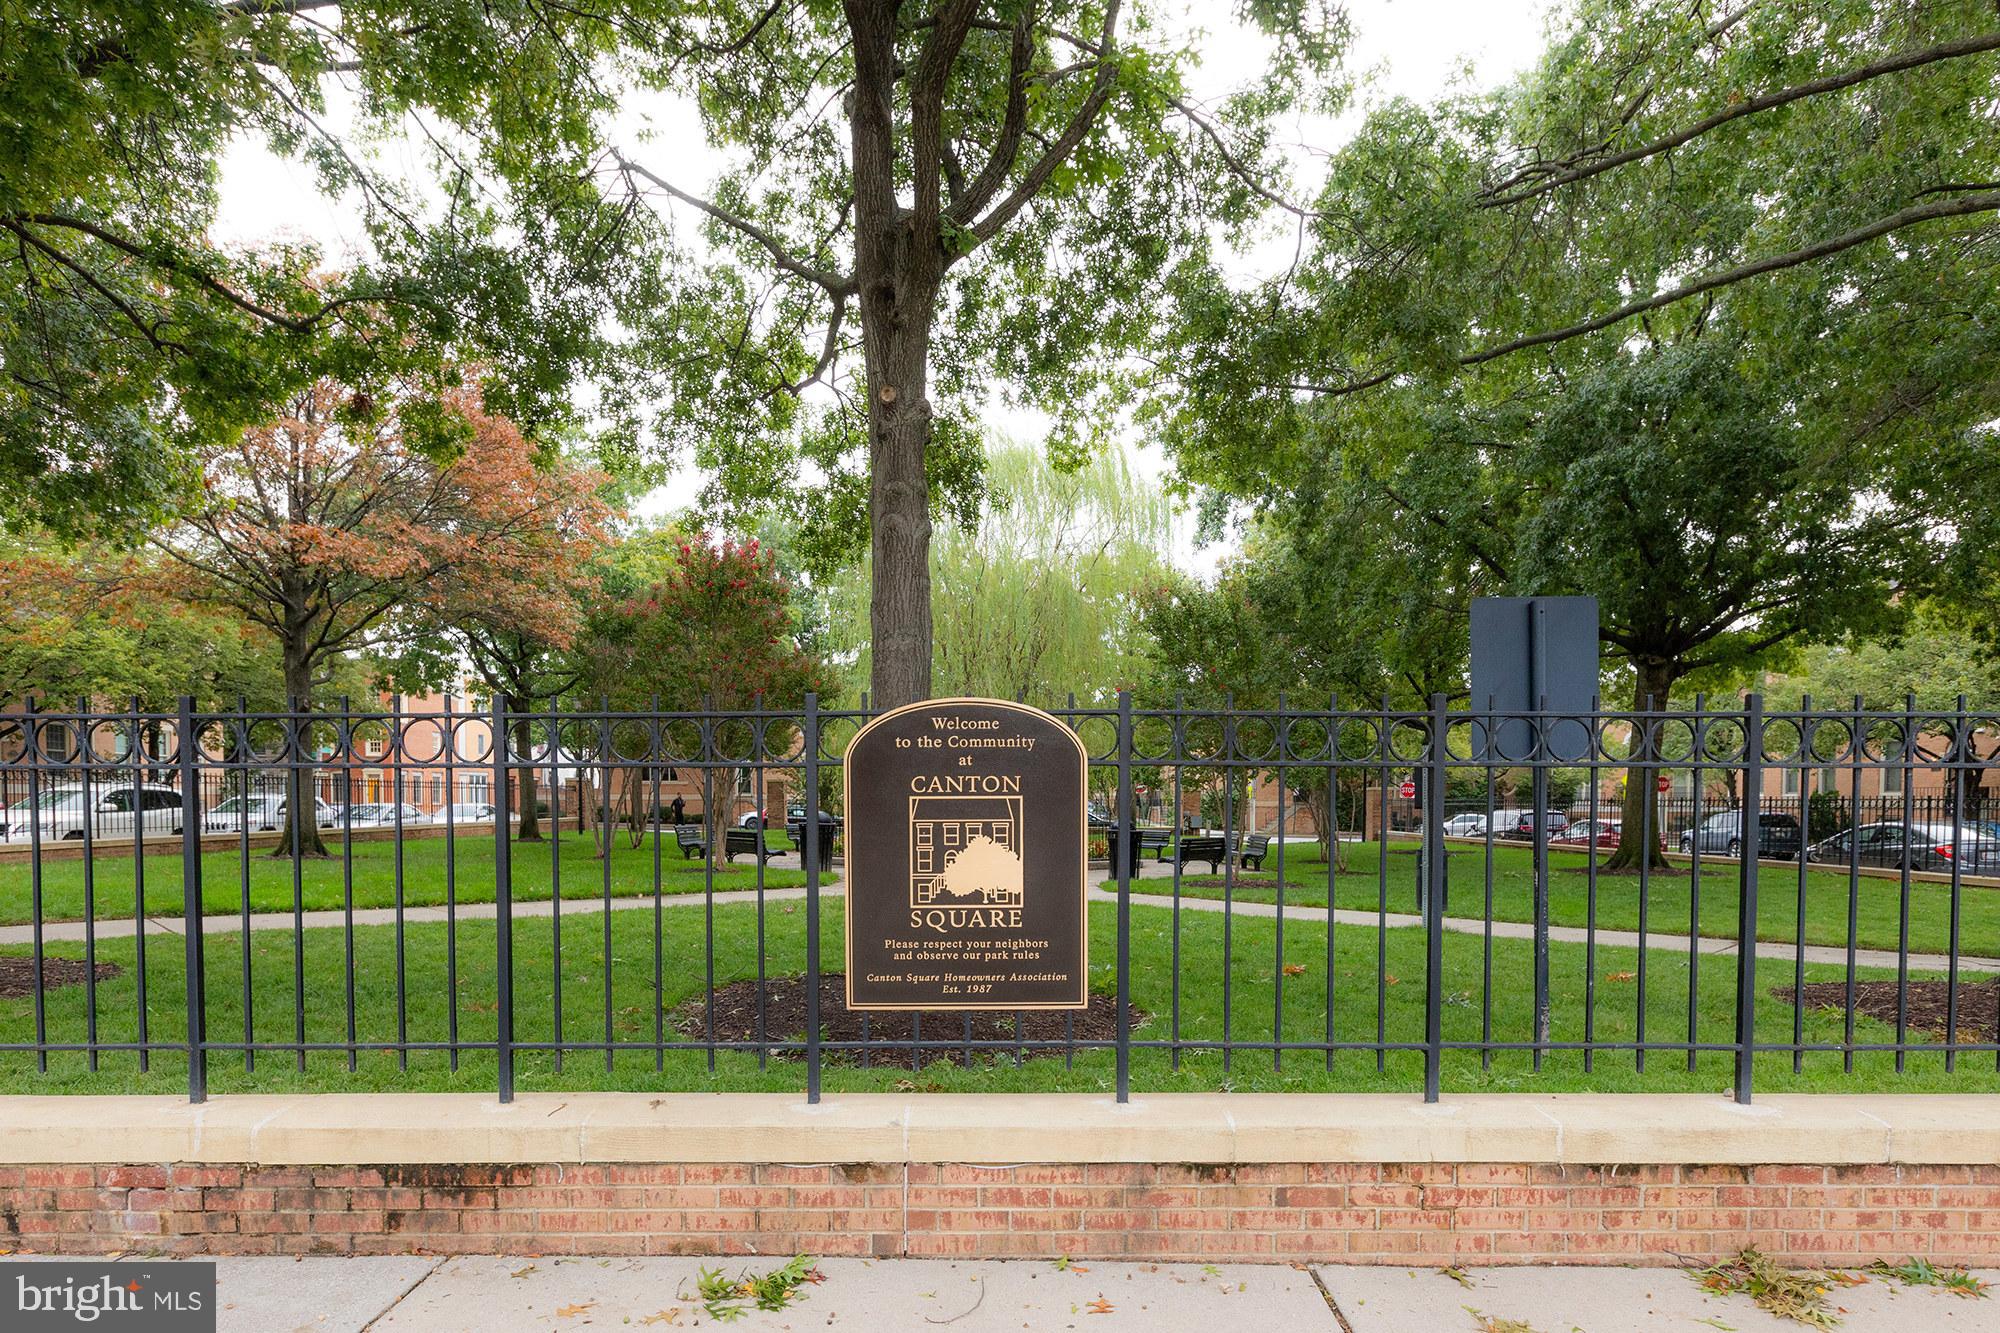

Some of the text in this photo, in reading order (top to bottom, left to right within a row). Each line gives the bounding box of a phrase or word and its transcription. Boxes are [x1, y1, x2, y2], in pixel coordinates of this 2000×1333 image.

[931, 717, 1000, 730] Welcome
[896, 735, 1036, 751] to the Community
[959, 755, 973, 766] at
[911, 775, 1022, 793] CANTON
[910, 910, 1023, 933] SQUARE
[885, 939, 1049, 951] Please respect your neighbors
[893, 950, 1040, 962] and observe our park rules
[866, 972, 1068, 984] Canton Square Homeowners Association
[942, 985, 993, 994] Est. 1987
